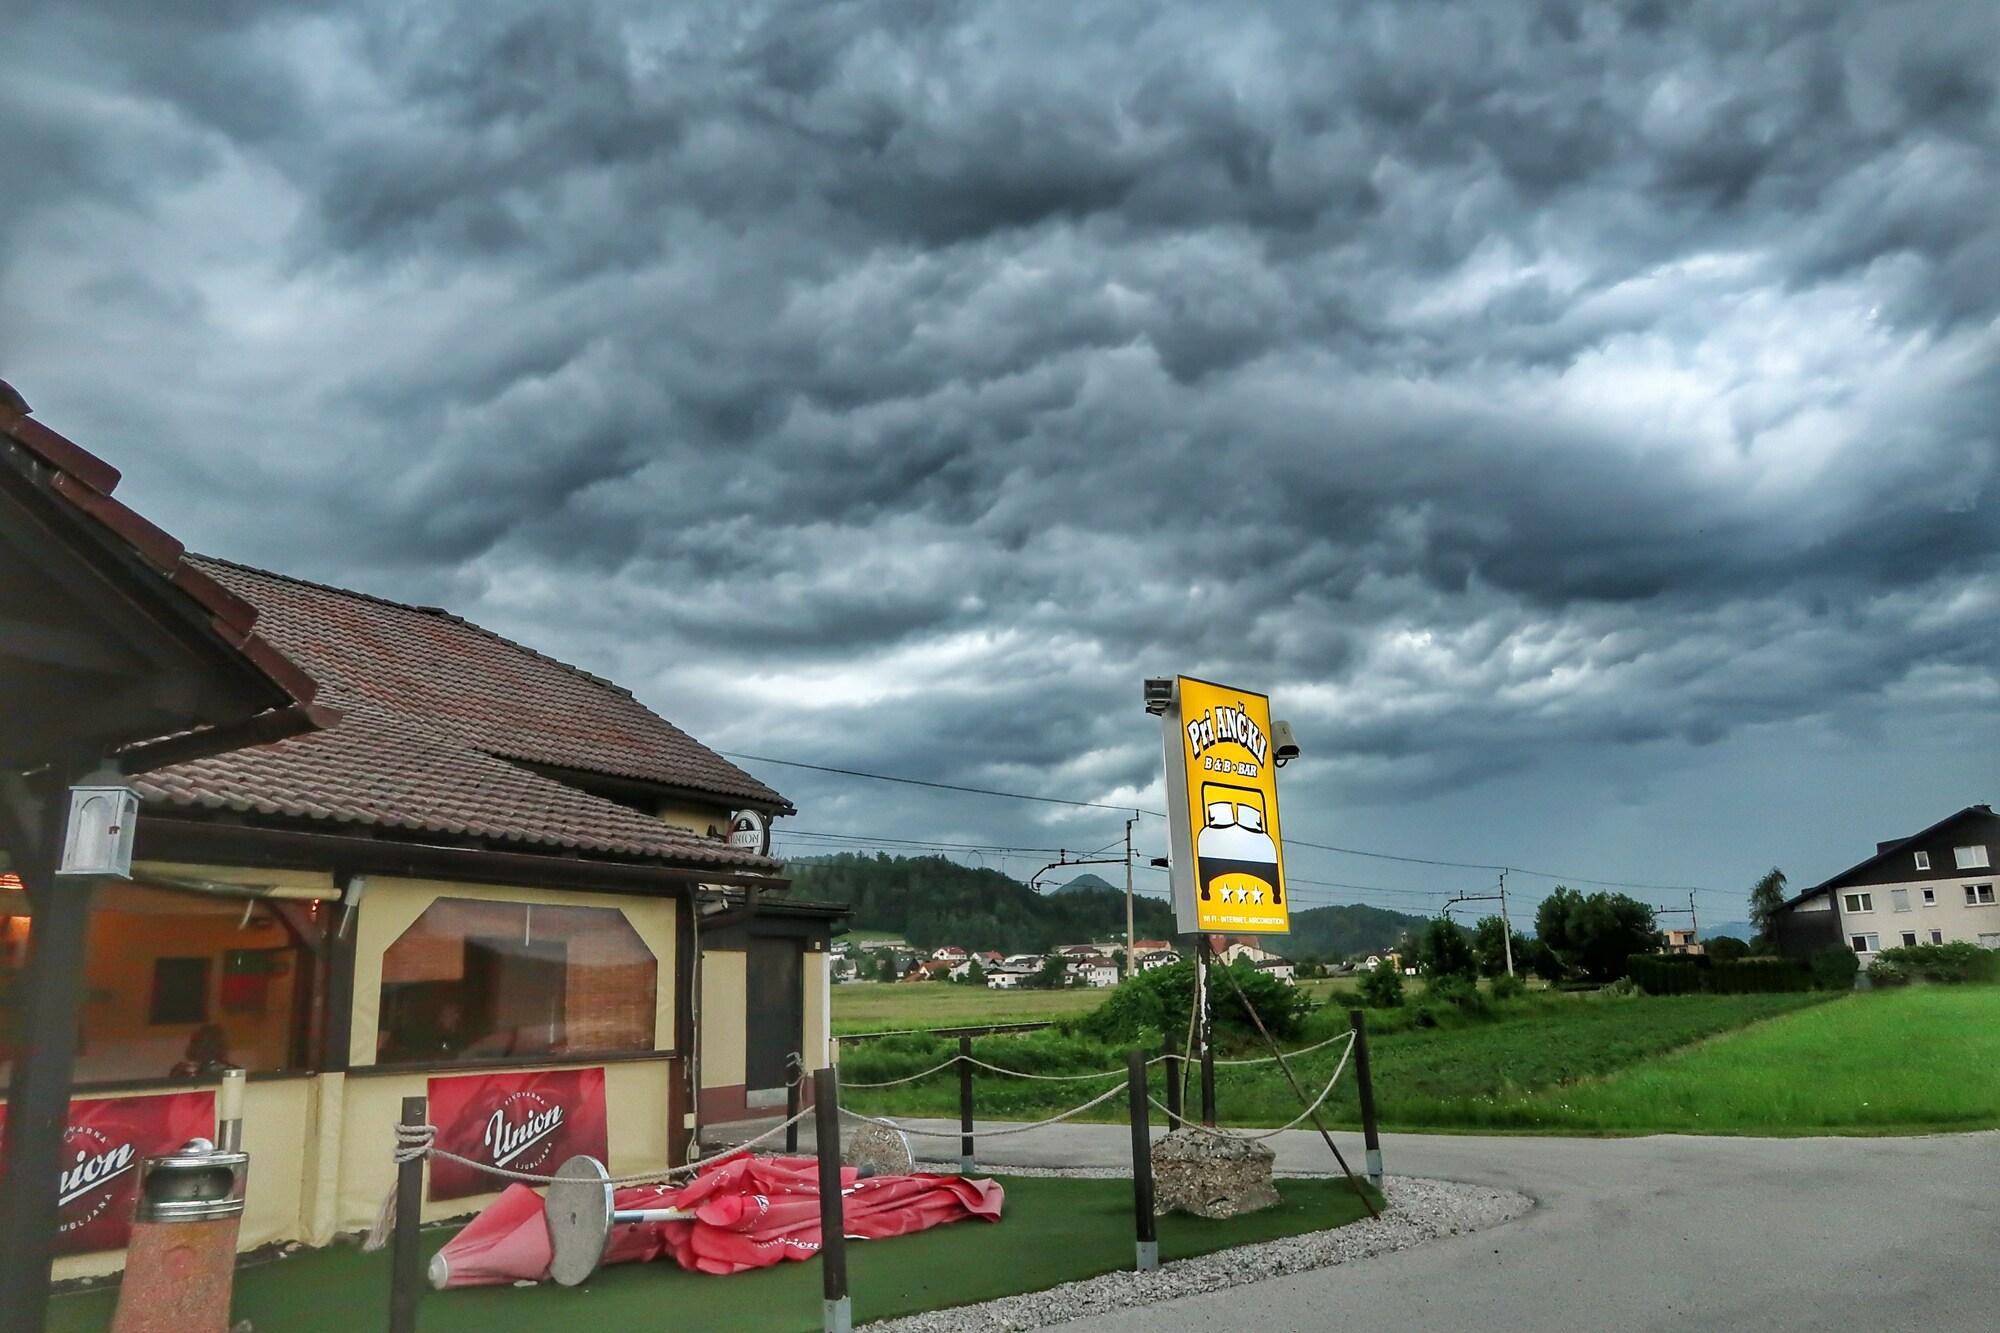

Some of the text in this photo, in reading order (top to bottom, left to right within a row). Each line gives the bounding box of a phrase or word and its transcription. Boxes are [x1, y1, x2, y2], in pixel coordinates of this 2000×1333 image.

[1215, 701, 1267, 768] ANČKI
[1238, 763, 1257, 777] BAR
[484, 1104, 564, 1160] Union
[515, 1142, 553, 1170] LJUBLJANA
[59, 1194, 112, 1231] UBLJANA
